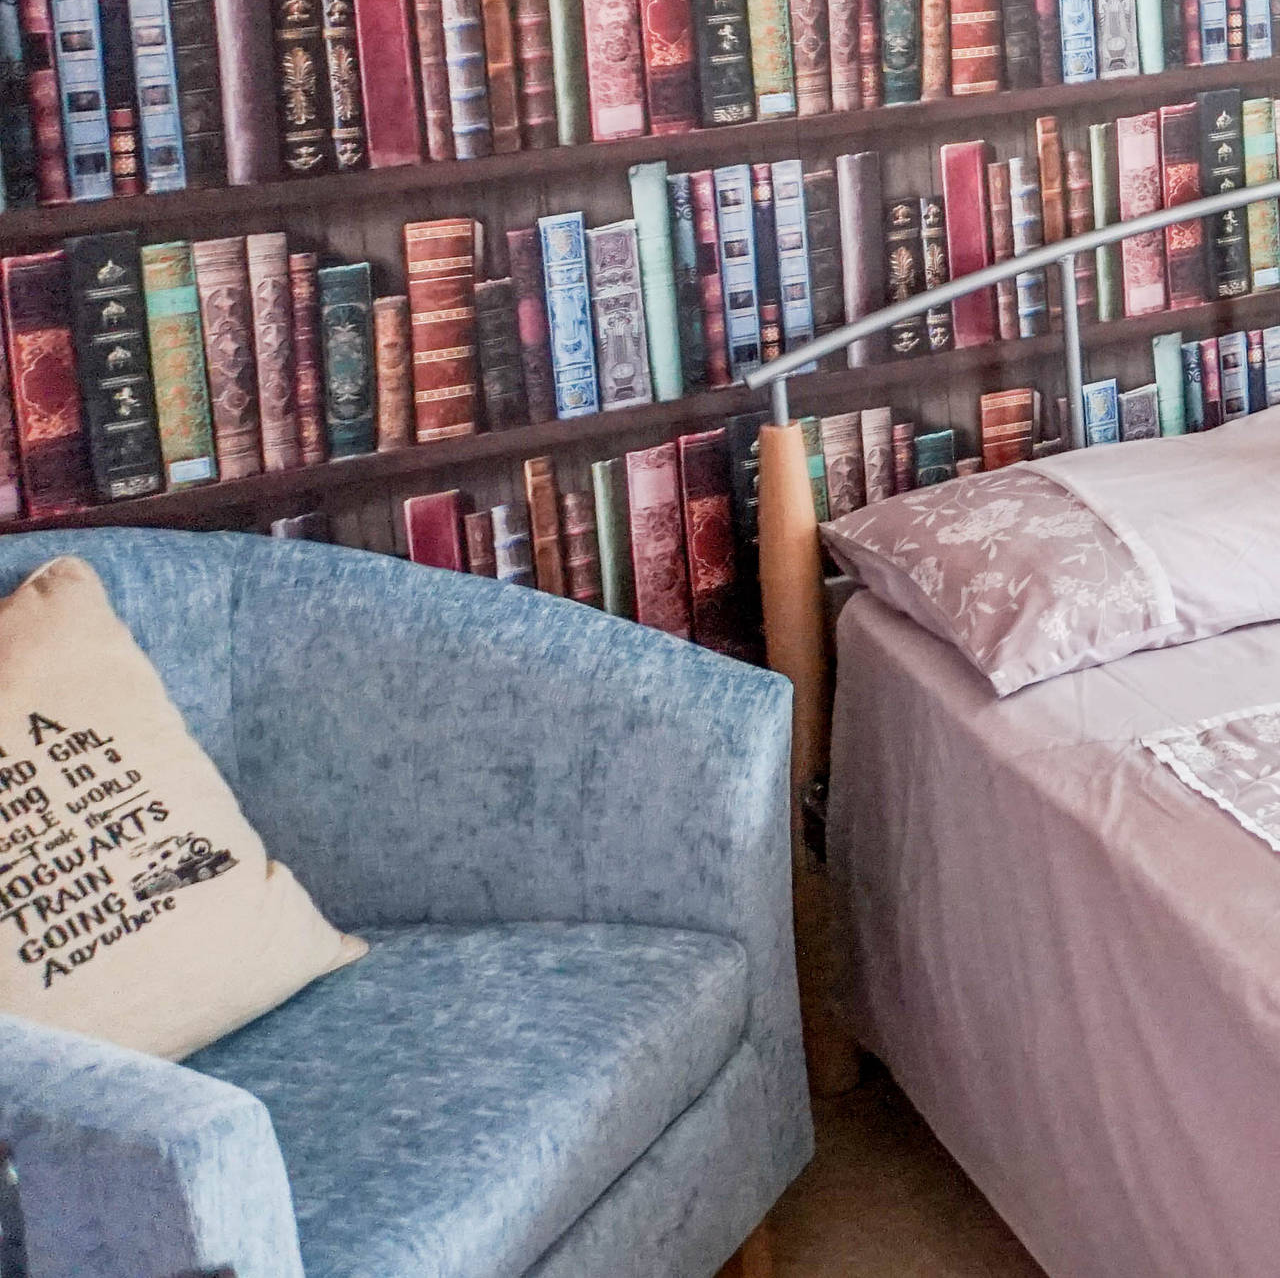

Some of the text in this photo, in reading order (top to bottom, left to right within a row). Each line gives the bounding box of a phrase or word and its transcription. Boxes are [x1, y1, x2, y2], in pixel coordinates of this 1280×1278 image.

[28, 711, 68, 746] A
[47, 728, 114, 763] GIRL
[61, 763, 96, 788] in
[104, 747, 122, 764] a
[66, 769, 142, 814] WORLD
[1, 865, 114, 935] TRAIN
[18, 891, 127, 964] GOING
[43, 895, 177, 989] Anywhere
